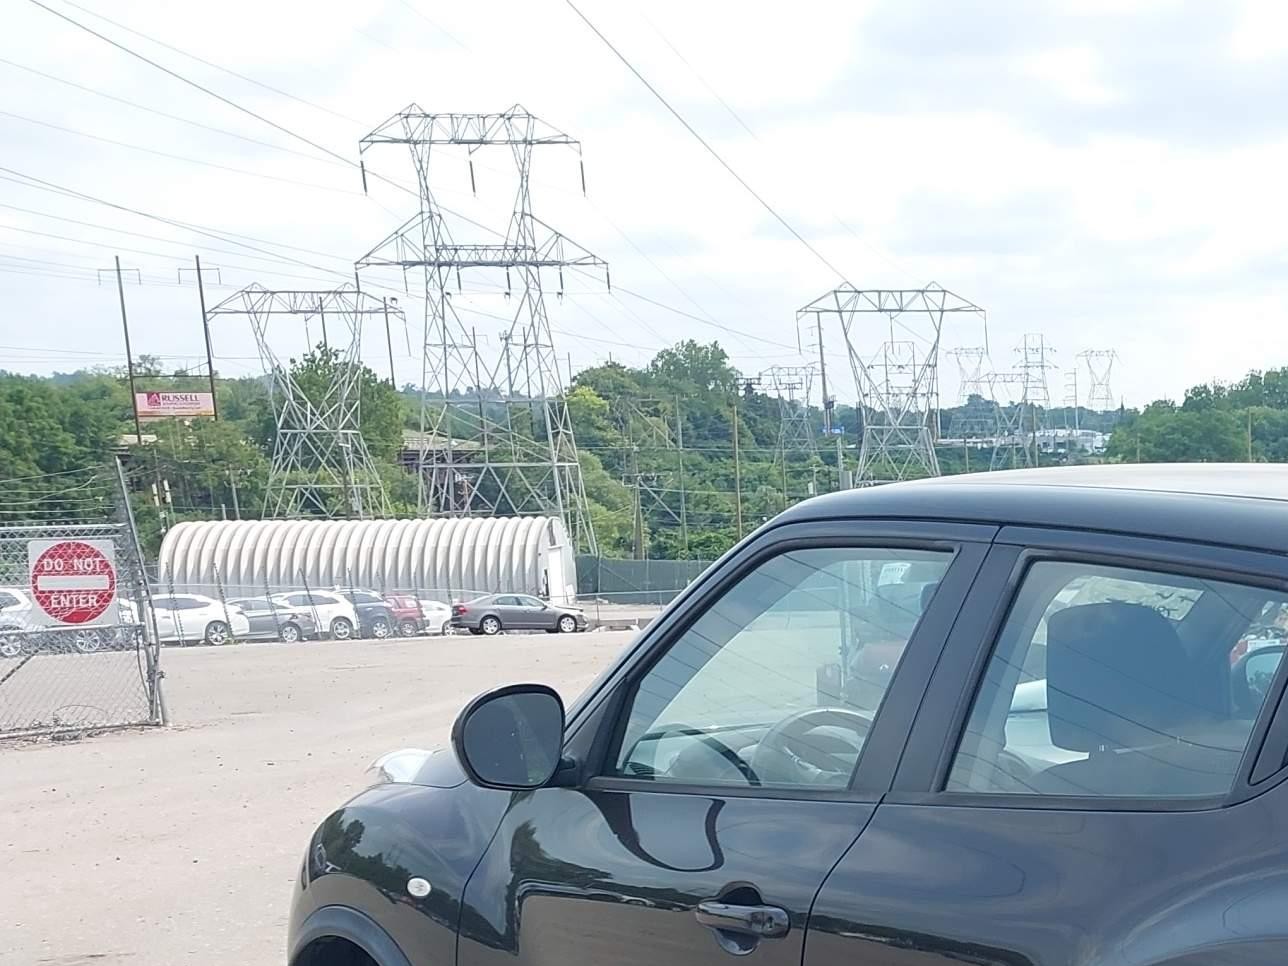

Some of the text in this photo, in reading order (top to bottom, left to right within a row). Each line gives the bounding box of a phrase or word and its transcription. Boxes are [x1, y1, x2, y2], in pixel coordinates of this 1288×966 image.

[161, 394, 200, 402] RUSSELL
[43, 558, 104, 571] DO NOT
[51, 594, 98, 608] ENTER
